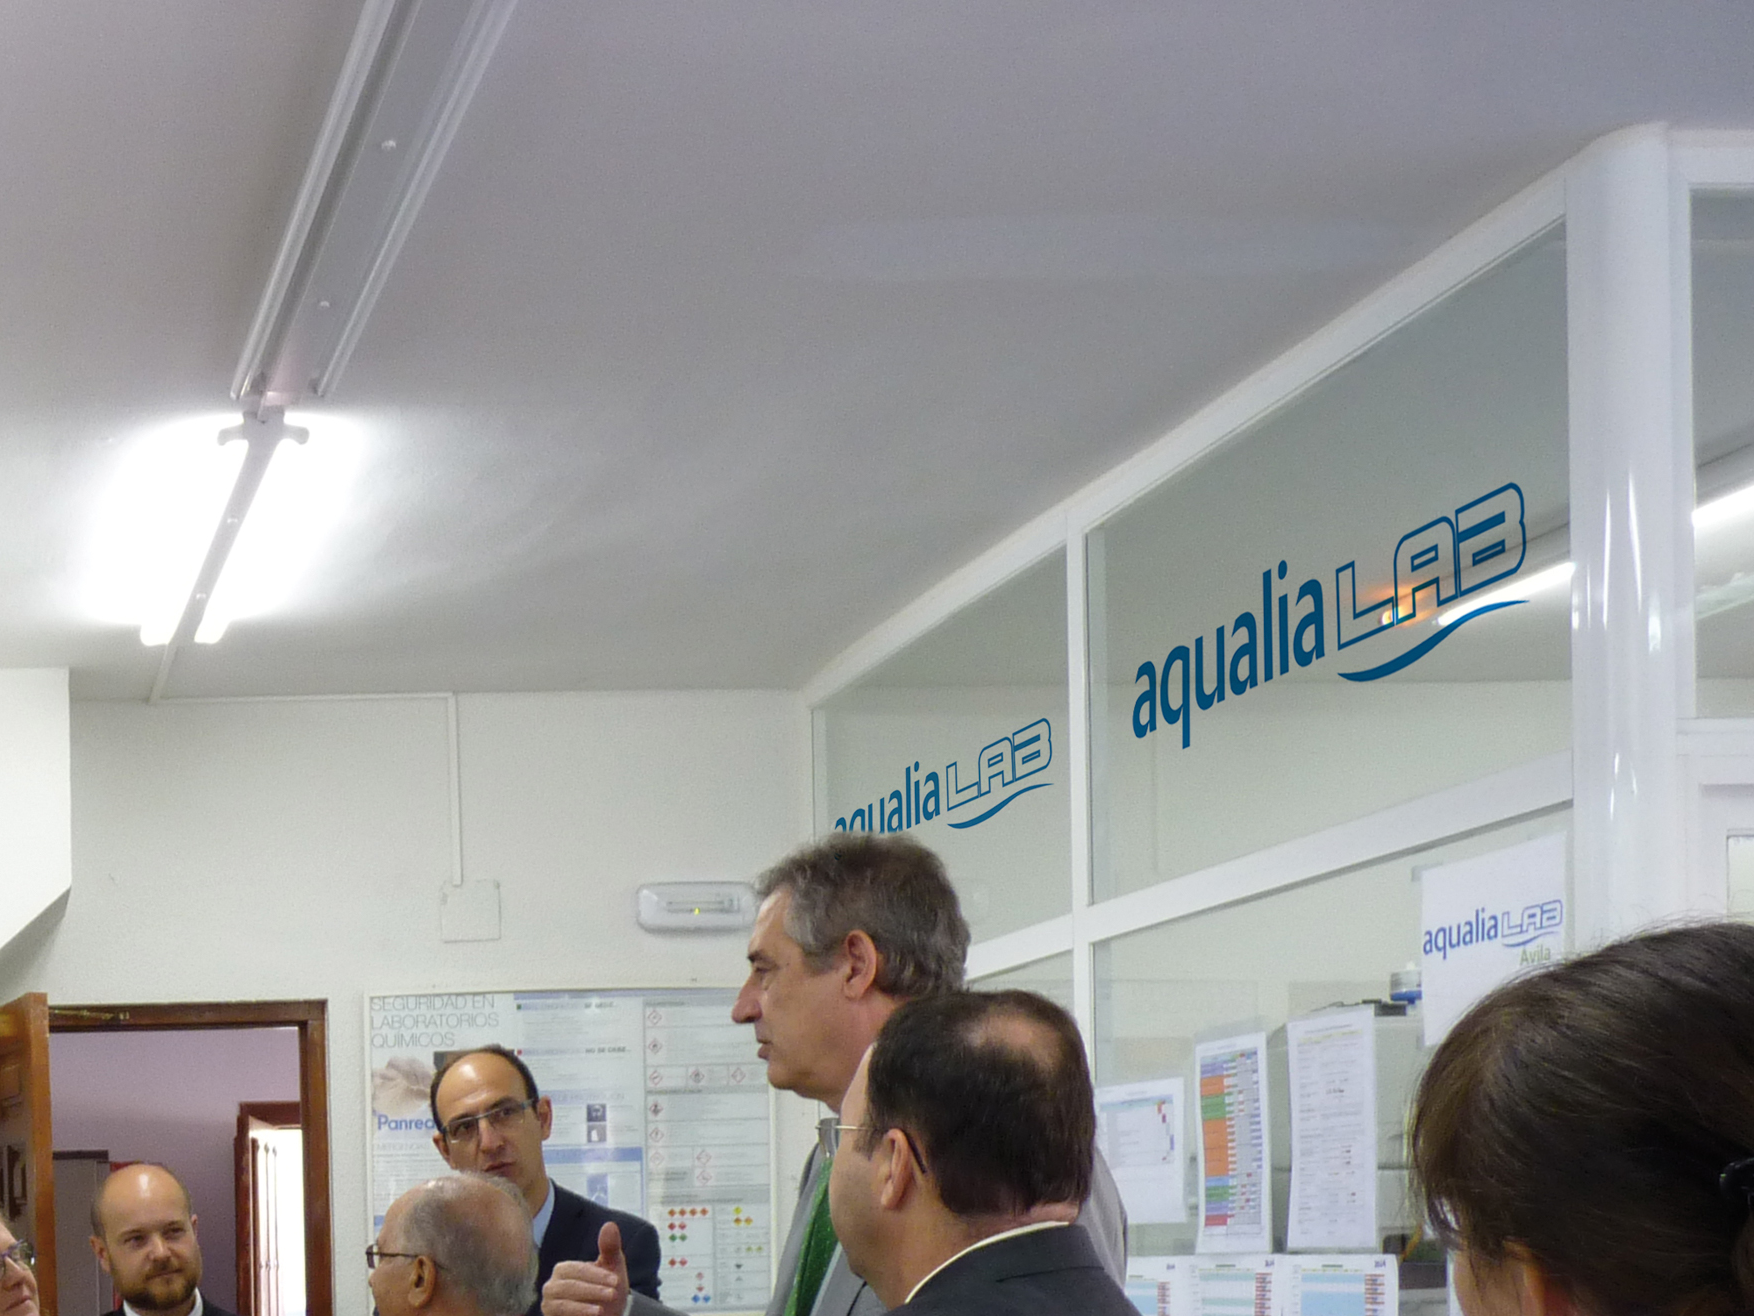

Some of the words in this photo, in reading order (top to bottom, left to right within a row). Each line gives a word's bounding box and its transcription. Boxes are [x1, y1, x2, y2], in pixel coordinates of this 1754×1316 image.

[1132, 560, 1325, 749] aqualia
[1335, 482, 1526, 651] LAB
[946, 717, 1053, 812] LAB
[1423, 907, 1498, 960] aqualia
[1501, 899, 1563, 938] LAB
[371, 995, 467, 1012] SEGURIDAD
[472, 993, 495, 1009] EN
[371, 1012, 499, 1031] LABORATORIOS
[378, 1114, 435, 1130] Panrea
